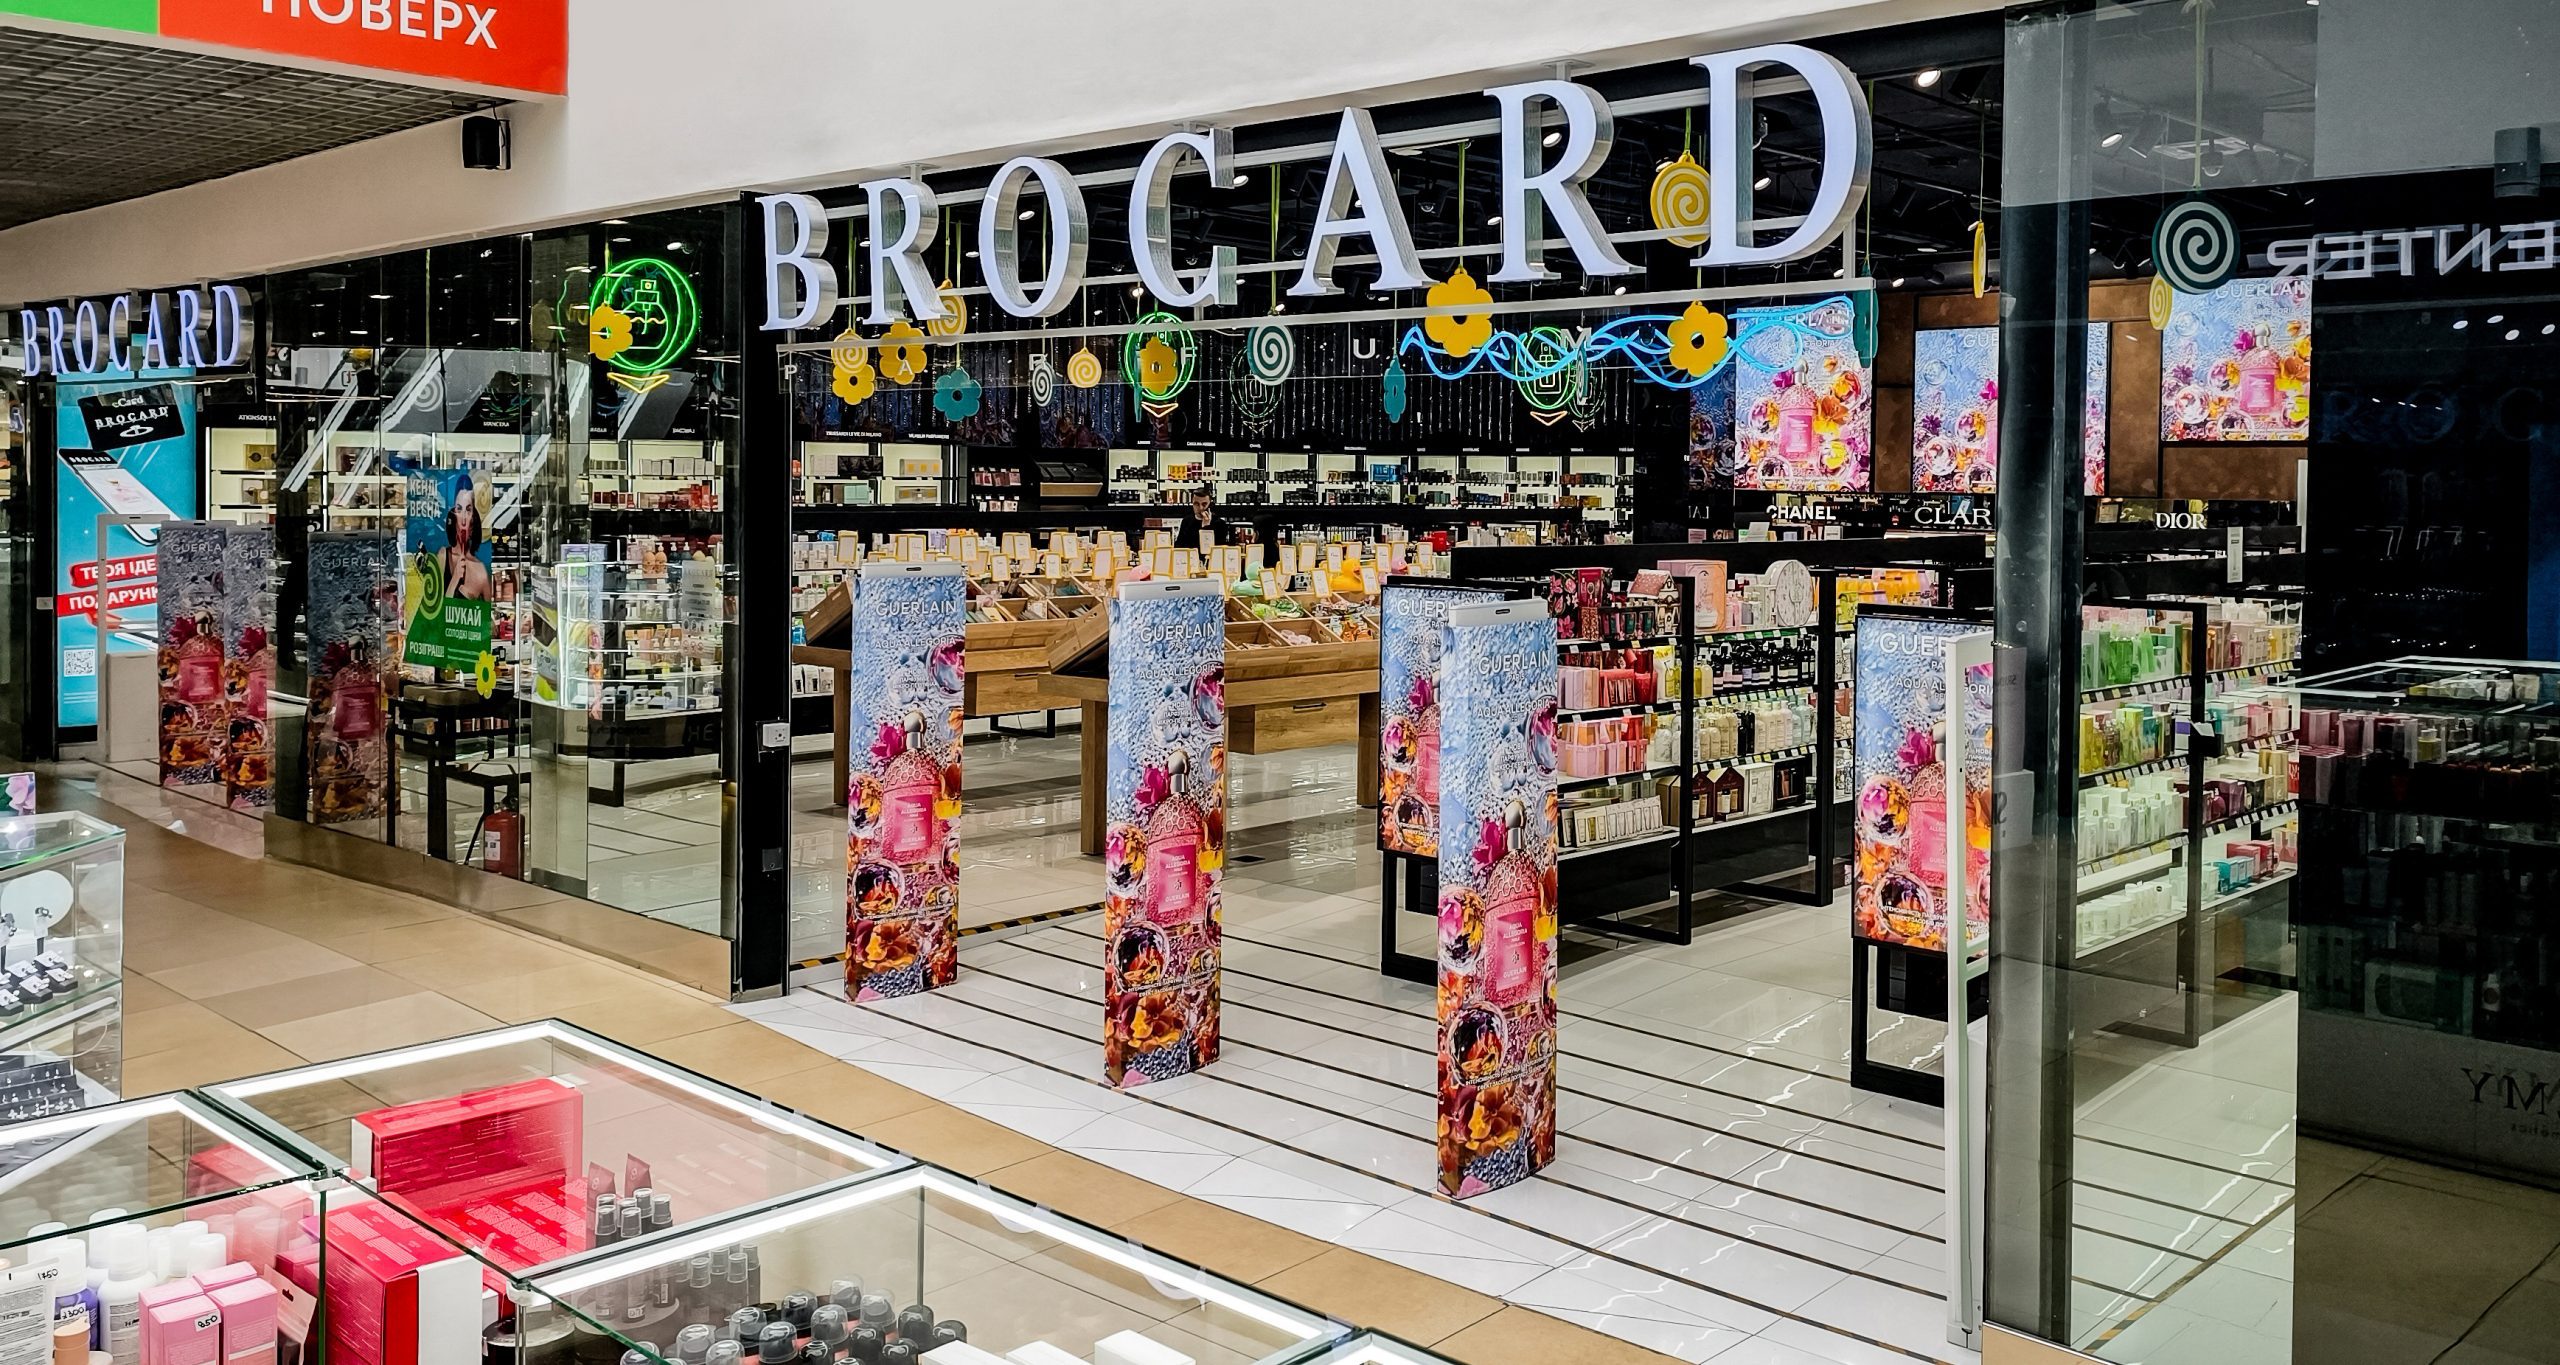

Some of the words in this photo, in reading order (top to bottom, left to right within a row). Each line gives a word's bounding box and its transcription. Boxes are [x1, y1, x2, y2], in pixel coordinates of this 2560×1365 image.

[755, 36, 1873, 332] BROCARD
[21, 285, 254, 377] BROCARD
[112, 395, 144, 408] eCard
[95, 406, 168, 430] BROCARD
[1766, 505, 1836, 521] CHANEL
[1915, 507, 1992, 525] CLAR
[2155, 513, 2206, 529] DIOR
[69, 585, 157, 610] ПОАРУНК
[445, 605, 482, 626] ШУКАЙ
[876, 600, 957, 616] GUERLAIN
[1140, 623, 1217, 642] GUERLAIN
[876, 639, 905, 649] AQUA
[906, 637, 957, 648] ALLEGORIA
[1139, 669, 1166, 679] AQUA
[1166, 664, 1216, 677] ALLEGORIA
[1478, 651, 1550, 675] GUERLAIN
[1896, 678, 1928, 690] AQUA
[1477, 706, 1504, 718] AQUA
[1505, 699, 1550, 714] ALLEGORIA
[198, 1314, 218, 1328] 850
